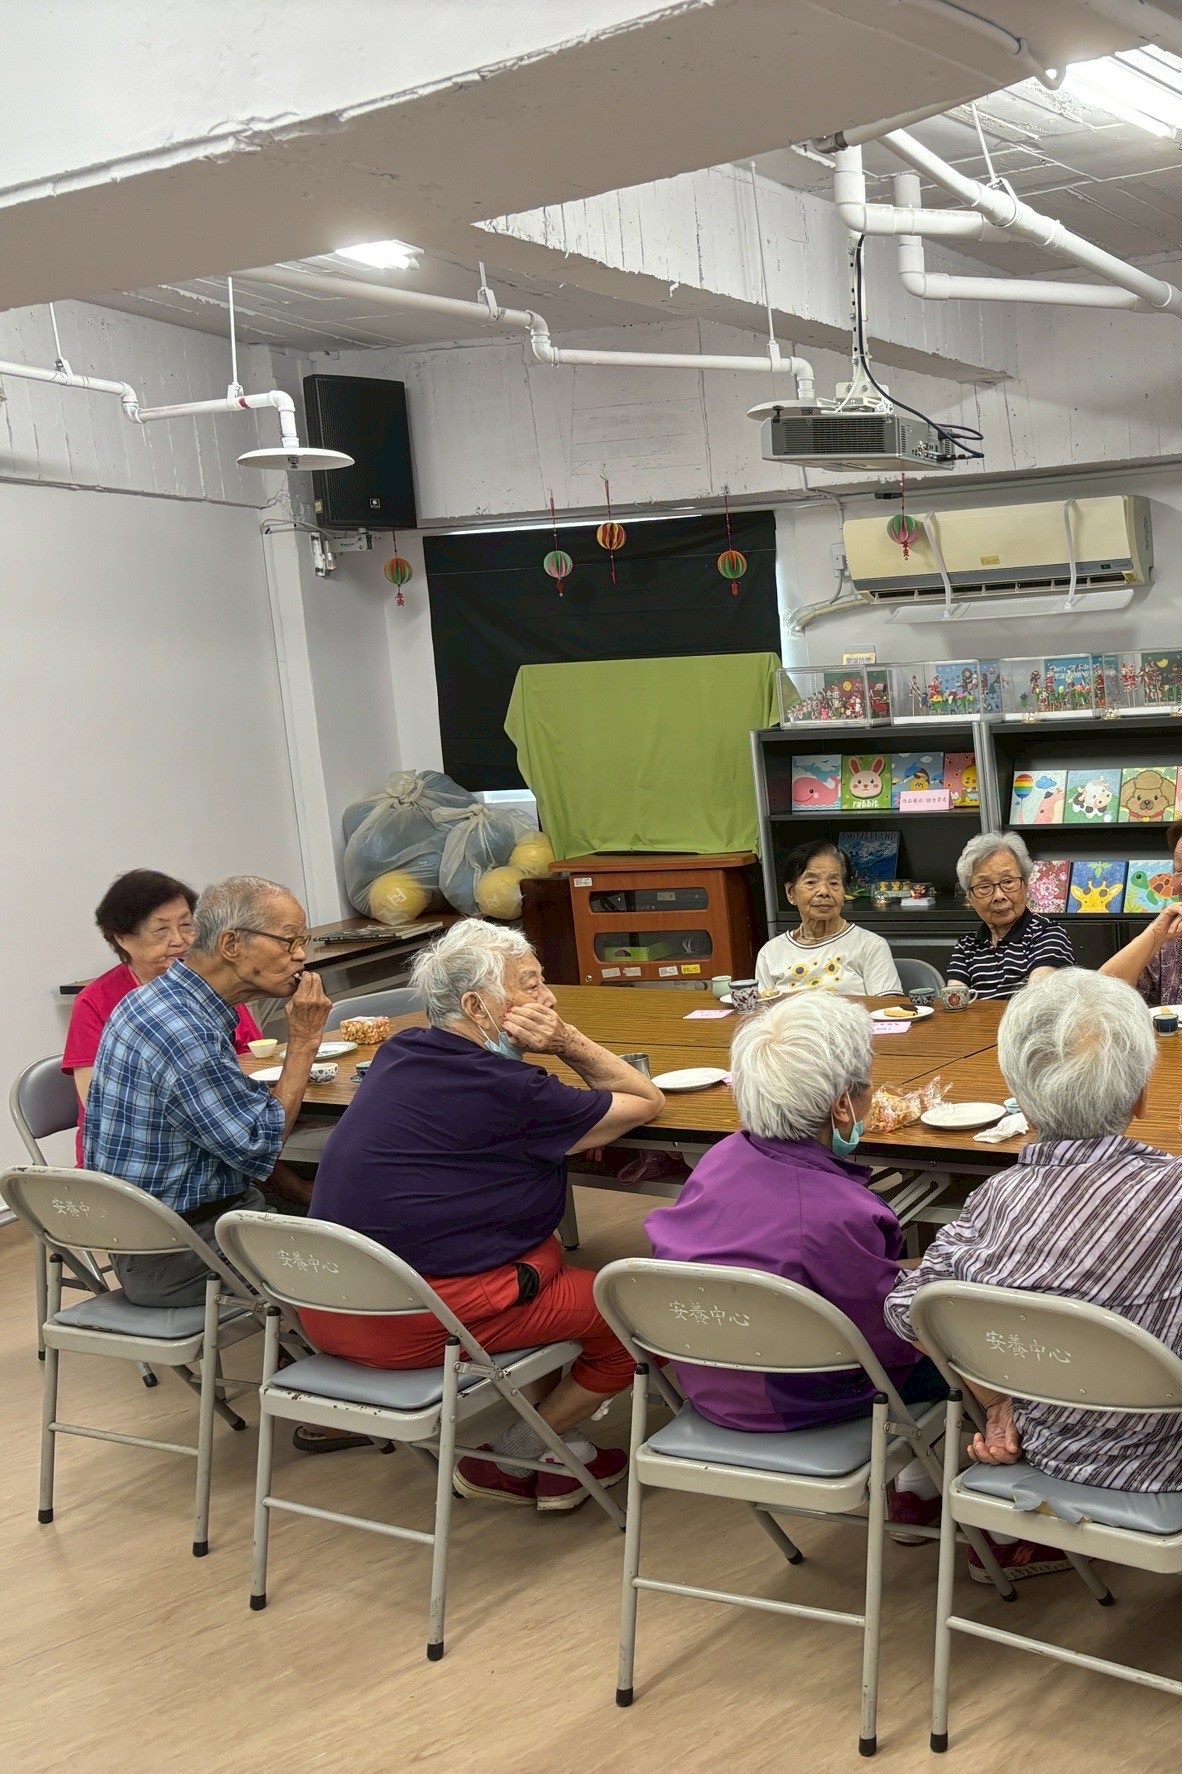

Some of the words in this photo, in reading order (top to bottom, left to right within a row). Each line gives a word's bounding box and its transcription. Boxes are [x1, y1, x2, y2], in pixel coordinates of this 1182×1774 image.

[852, 799, 879, 808] rabbit
[841, 831, 896, 840] SWITZERLAND
[276, 1249, 339, 1273] 安養中心
[669, 1300, 750, 1326] 安養中心
[985, 1330, 1071, 1363] 安養中心
